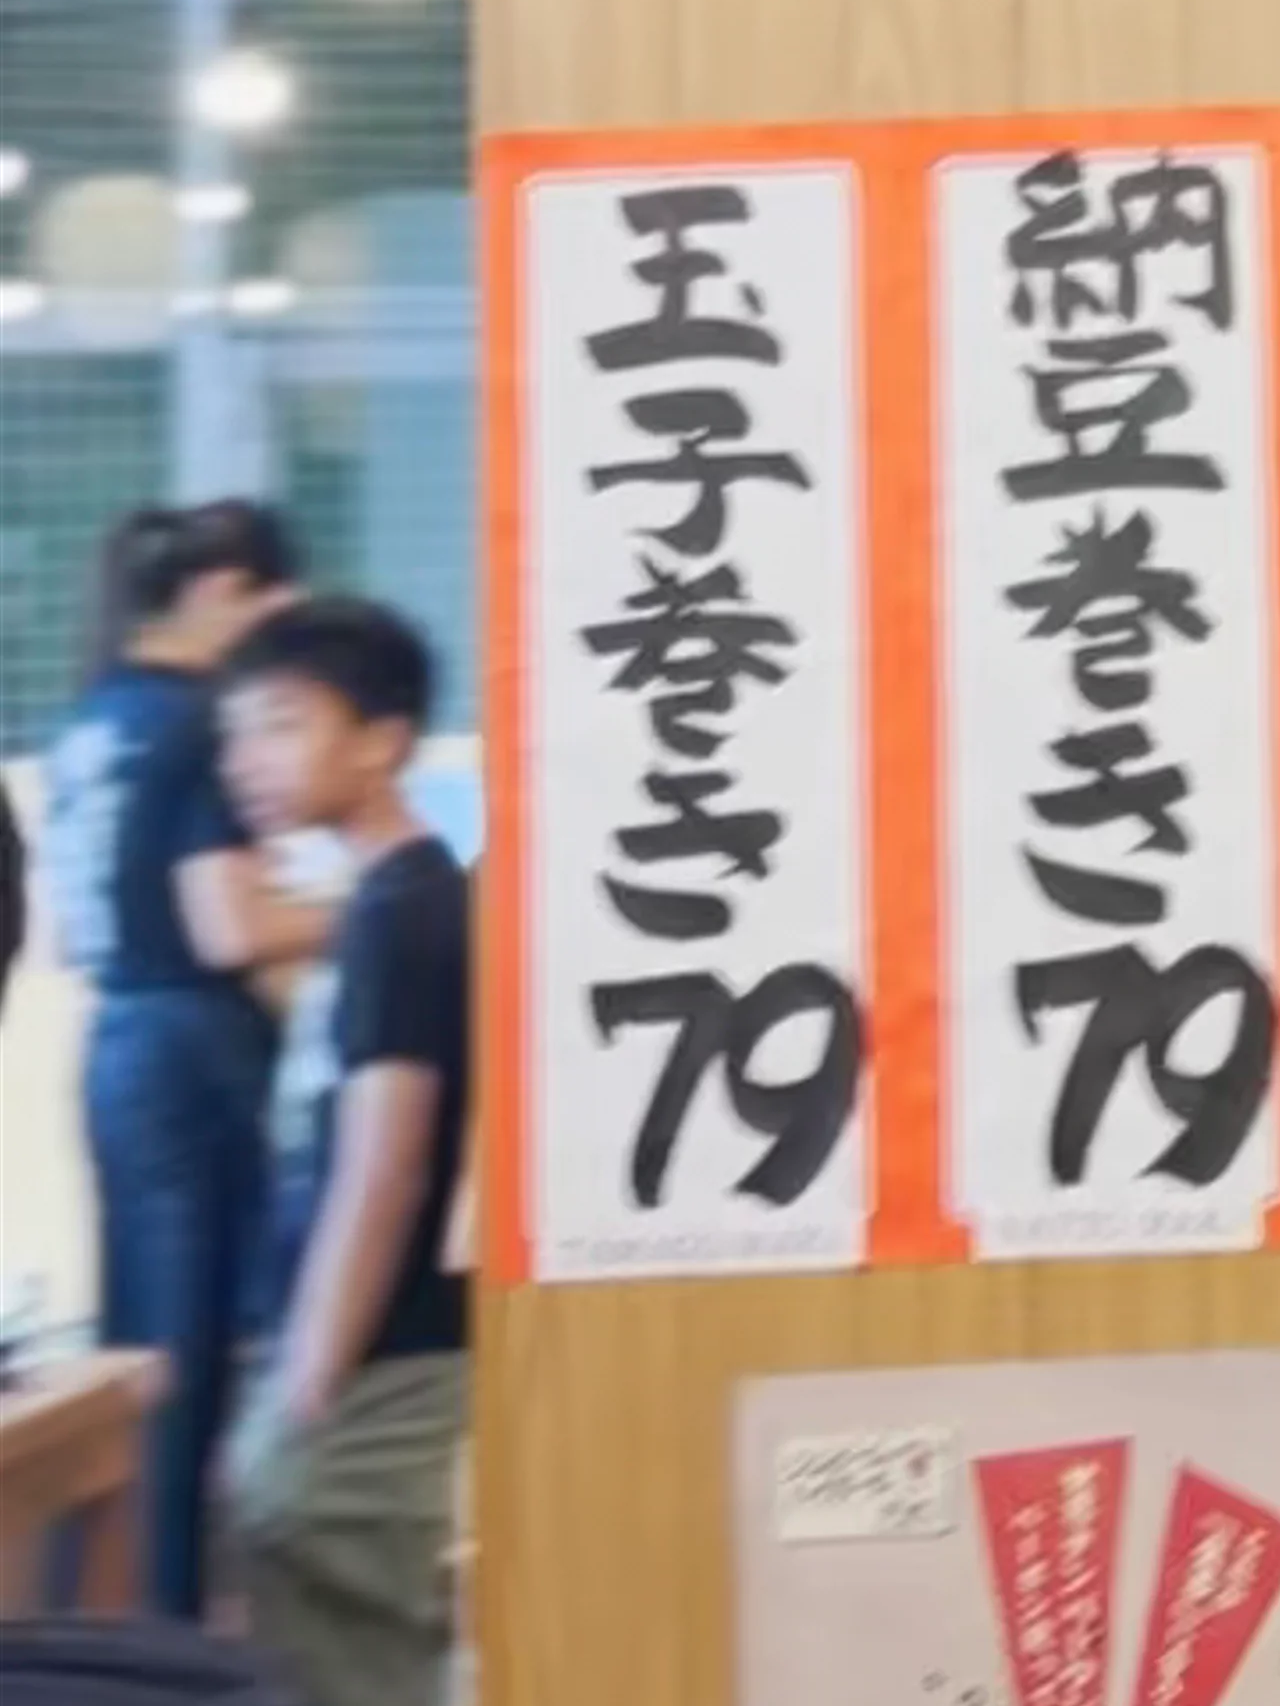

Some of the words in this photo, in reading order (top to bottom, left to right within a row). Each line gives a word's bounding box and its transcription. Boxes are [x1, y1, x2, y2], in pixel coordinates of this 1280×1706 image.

[581, 187, 810, 941] 玉子巻き
[1003, 148, 1232, 926] 納豆巻き
[590, 962, 868, 1208] 79
[1014, 942, 1280, 1187] 79
